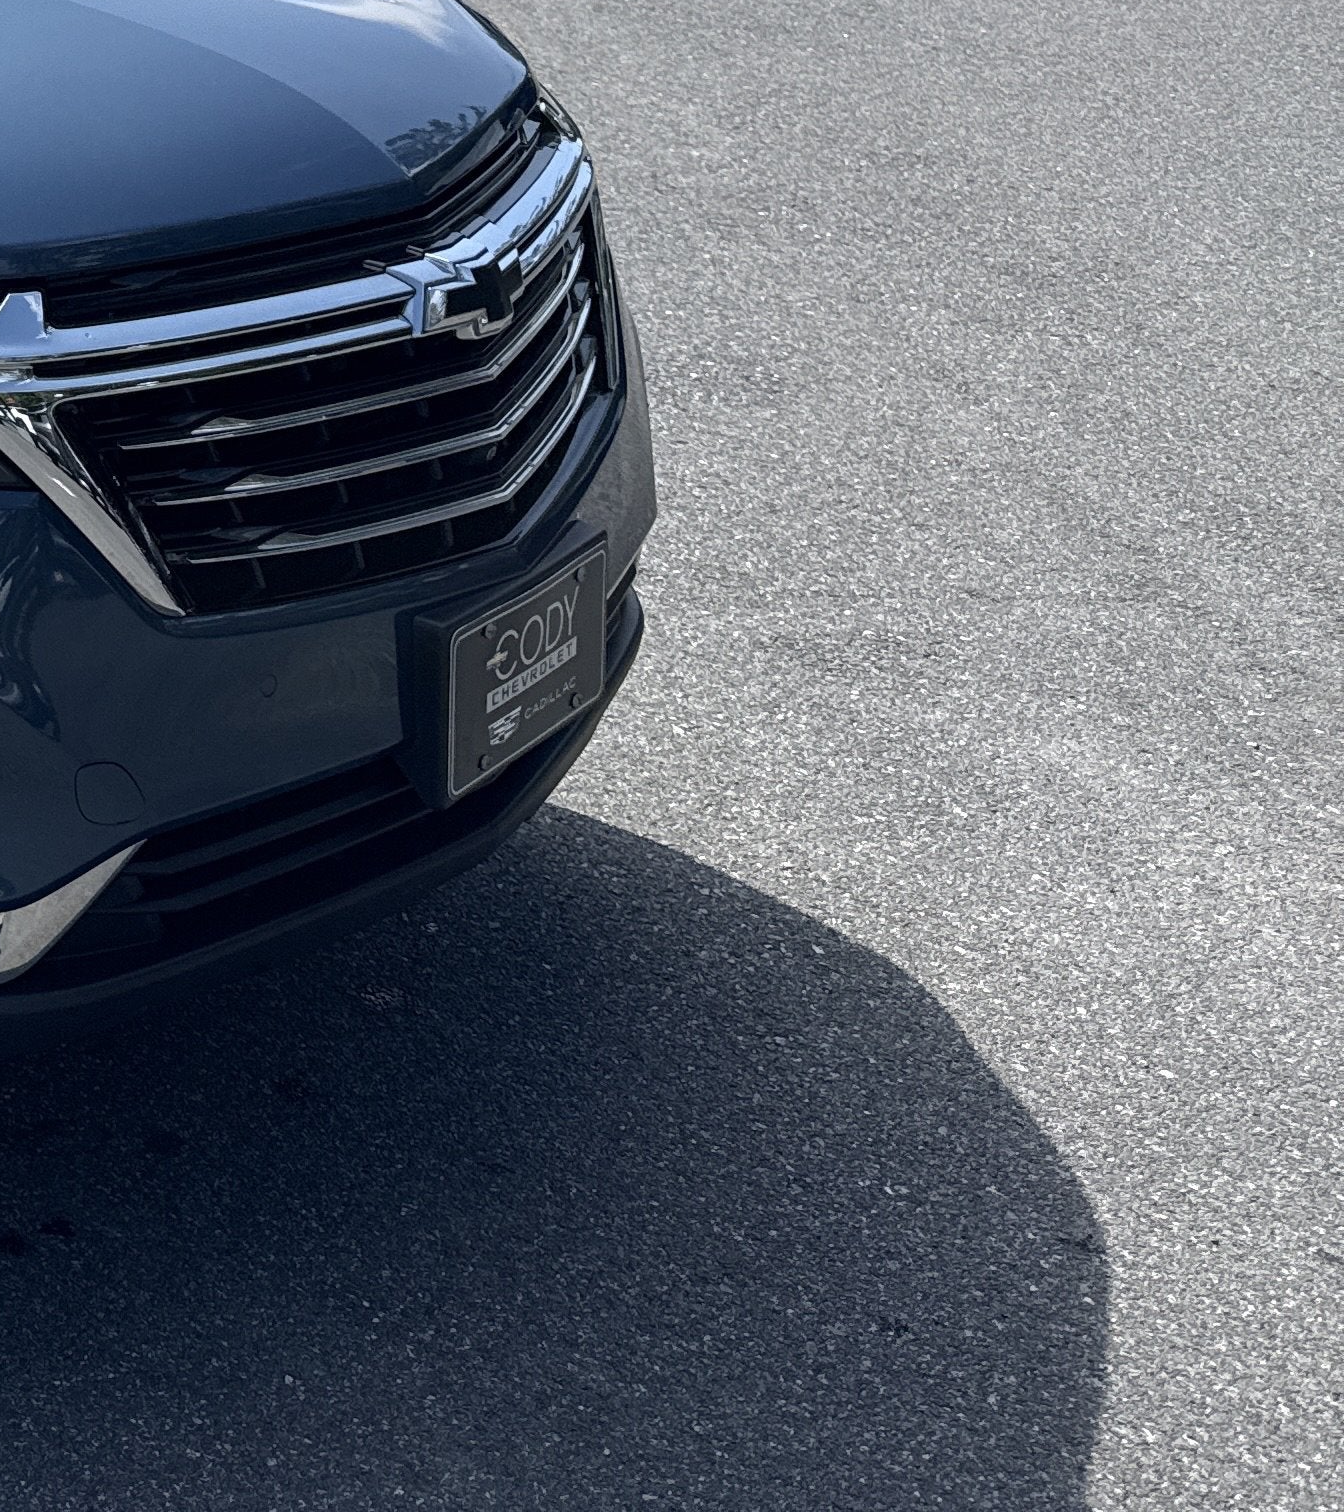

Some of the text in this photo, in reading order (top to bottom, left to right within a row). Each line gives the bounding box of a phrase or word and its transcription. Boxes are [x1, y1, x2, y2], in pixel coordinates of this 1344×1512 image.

[494, 585, 579, 680] CODY
[490, 641, 576, 708] CHEVROLET
[524, 676, 577, 720] CADILLAC
